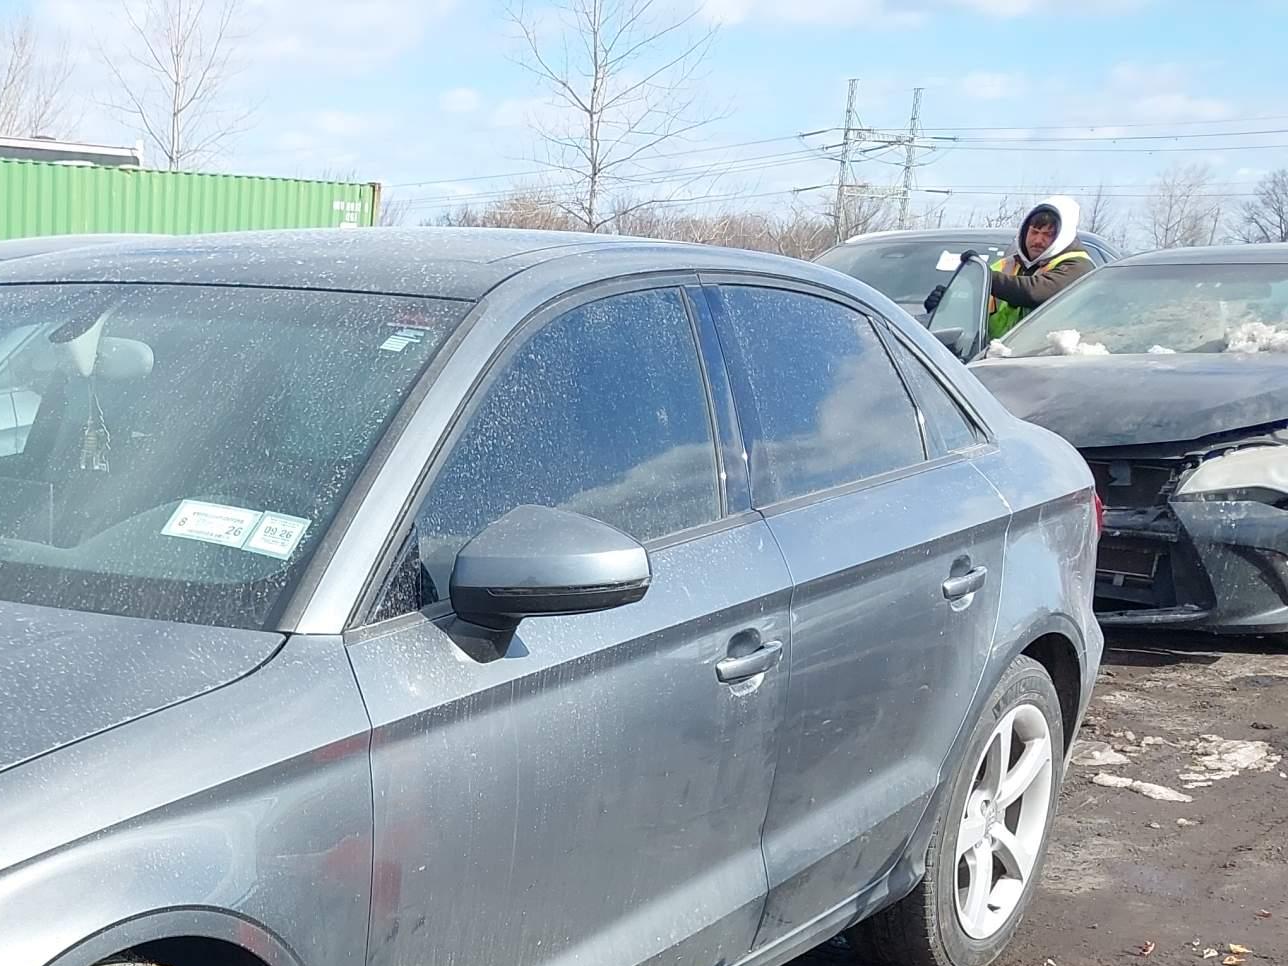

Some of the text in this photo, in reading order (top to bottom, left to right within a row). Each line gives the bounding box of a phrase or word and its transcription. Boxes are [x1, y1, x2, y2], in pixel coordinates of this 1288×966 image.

[225, 526, 243, 537] 26
[263, 525, 294, 539] 09 26
